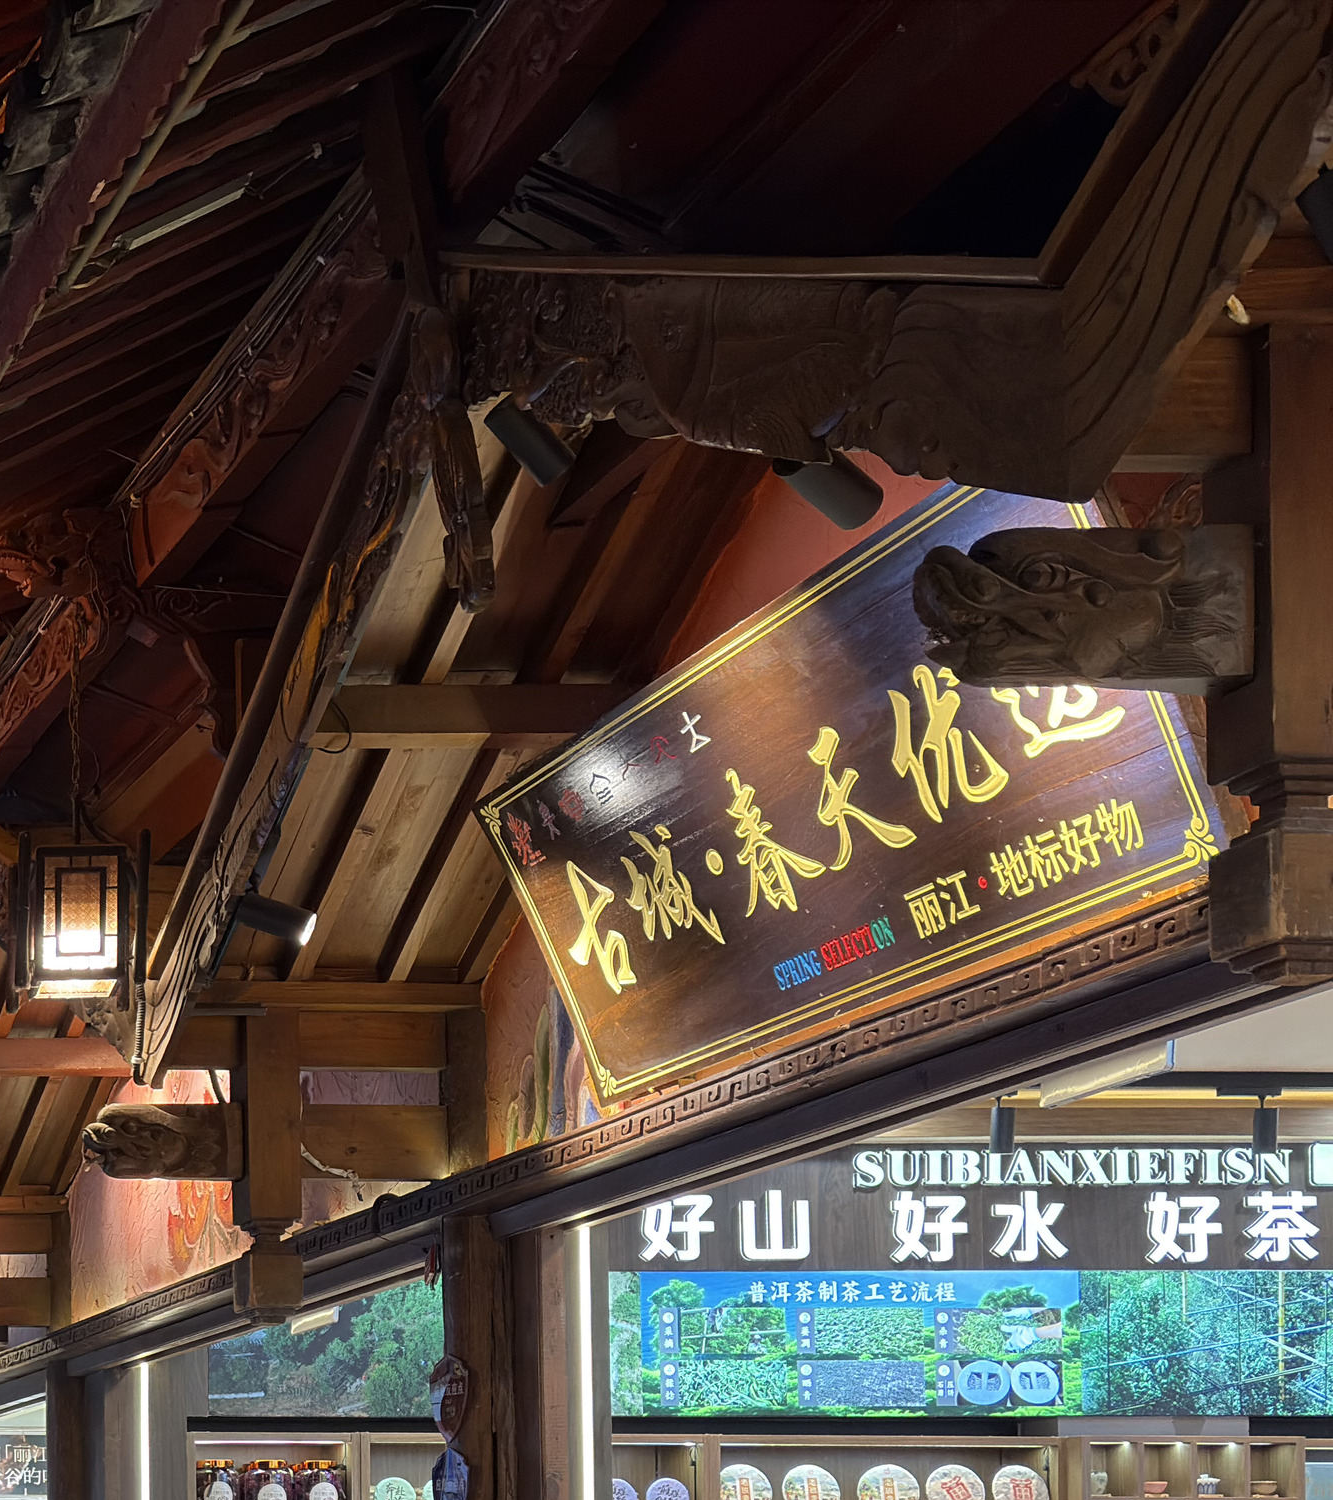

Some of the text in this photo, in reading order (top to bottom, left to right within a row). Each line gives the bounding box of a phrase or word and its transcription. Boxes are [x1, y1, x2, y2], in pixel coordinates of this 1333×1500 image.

[903, 798, 1145, 939] 丽江·地标好物
[773, 914, 896, 991] SPRING SELECTION
[638, 1189, 1320, 1263] 好山 好水 好茶
[748, 1280, 957, 1303] 普洱茶制茶工艺流程
